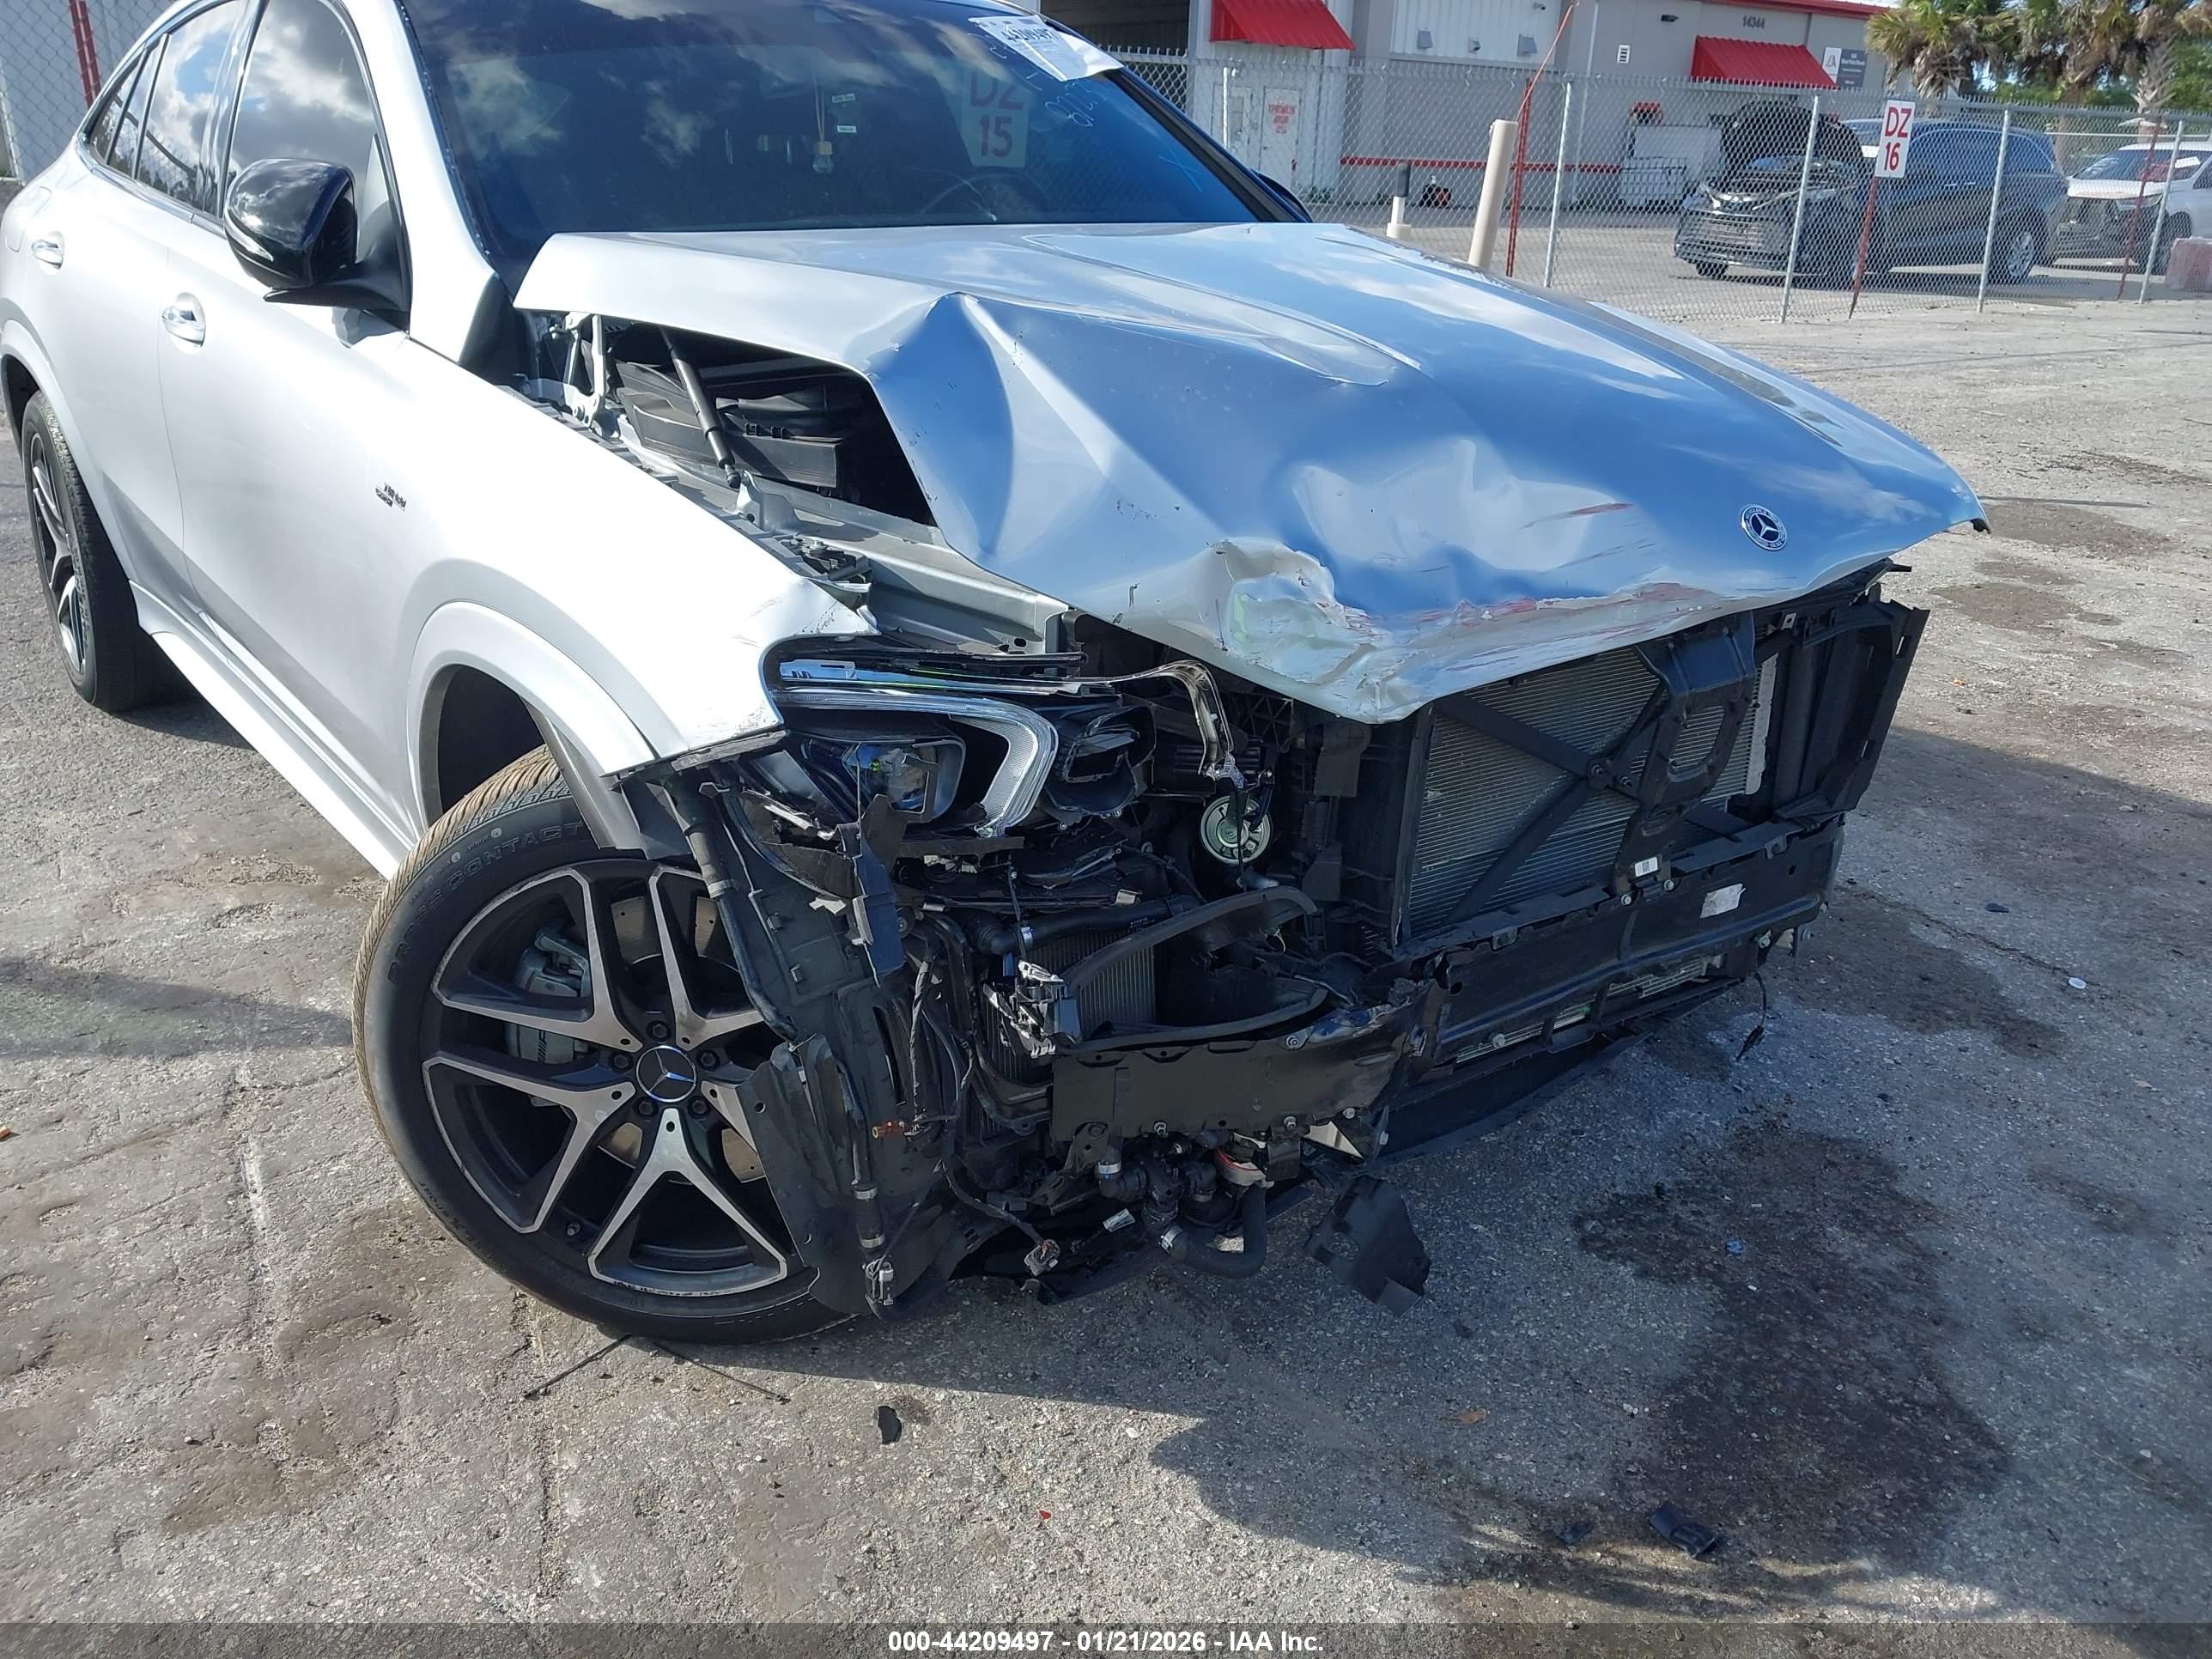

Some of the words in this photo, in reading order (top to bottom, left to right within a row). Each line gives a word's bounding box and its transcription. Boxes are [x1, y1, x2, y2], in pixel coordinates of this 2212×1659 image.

[979, 114, 1013, 157] 15
[1885, 106, 1912, 138] DZ
[1883, 142, 1901, 171] 16
[446, 819, 585, 891] CONTACT
